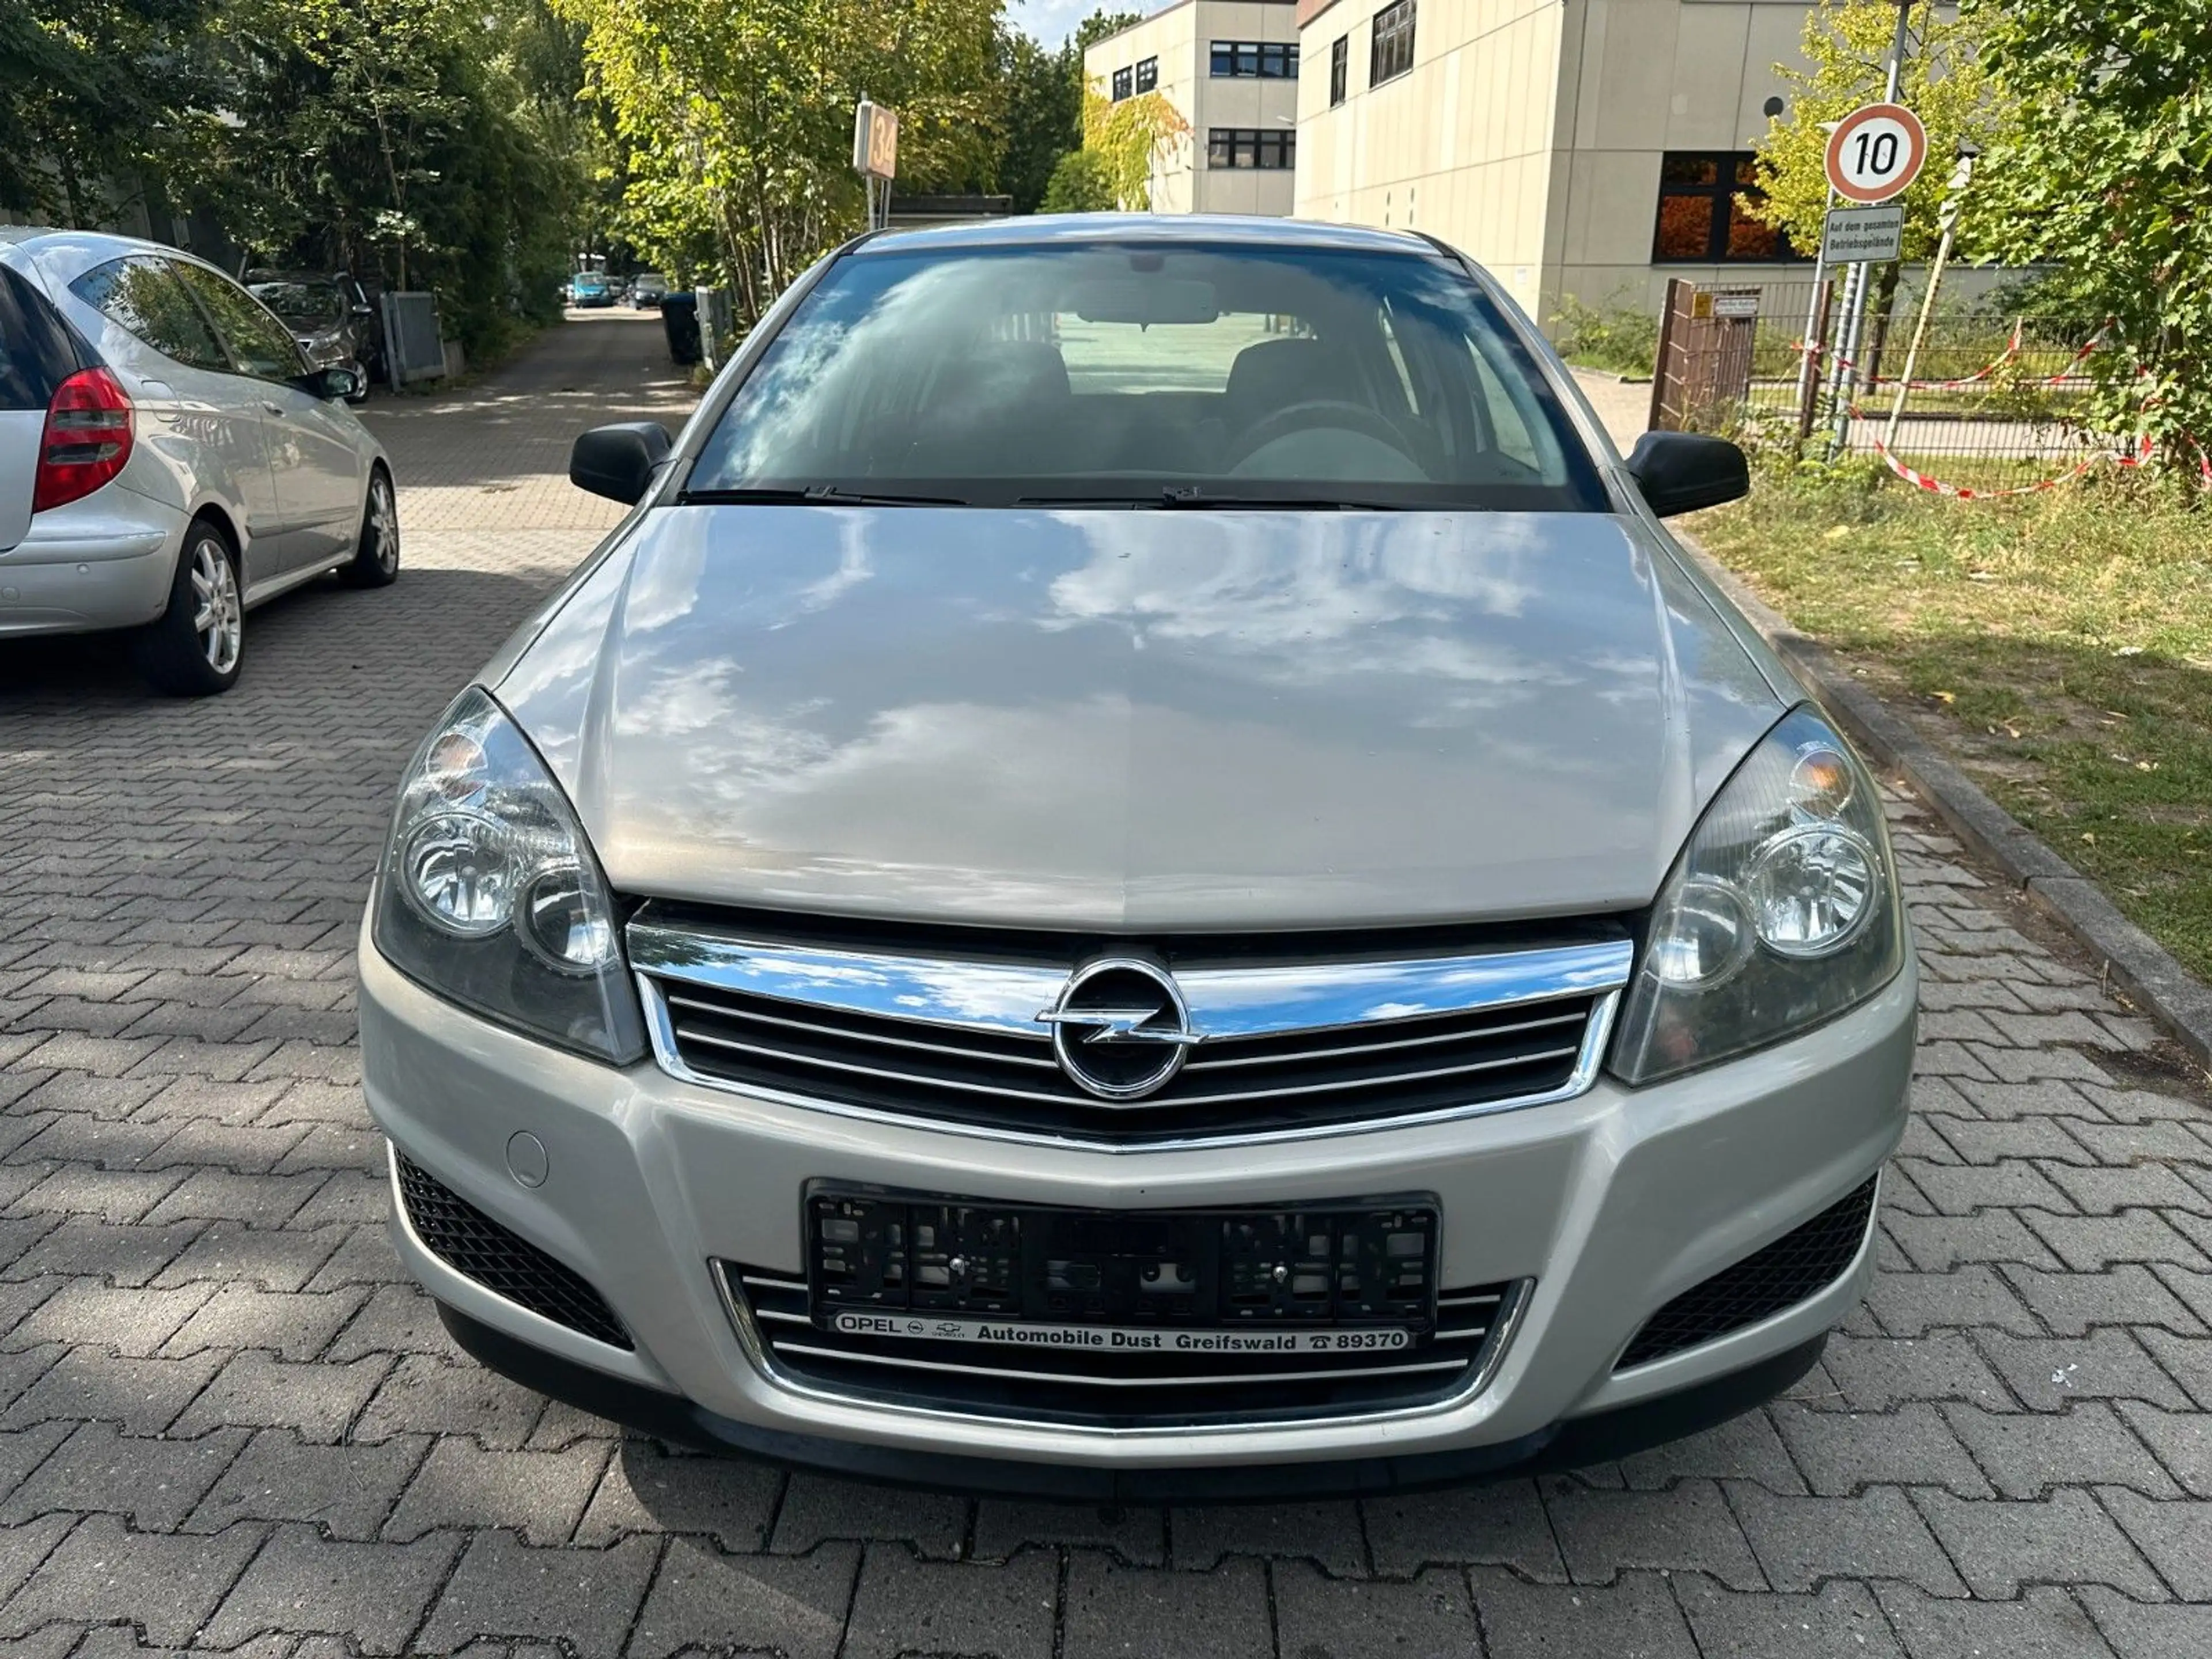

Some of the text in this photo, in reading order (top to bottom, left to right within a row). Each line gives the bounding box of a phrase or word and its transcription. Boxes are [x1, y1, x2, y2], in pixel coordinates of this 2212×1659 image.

[874, 115, 896, 166] 34
[1855, 132, 1898, 175] 10
[1830, 220, 1899, 232] Auf dem gesamten
[1830, 236, 1894, 250] Betriebsgelände
[841, 1316, 902, 1332] OPEL
[978, 1325, 1104, 1346] Automobile
[1111, 1332, 1162, 1347] Dust
[1175, 1334, 1296, 1350] Greifswald
[1336, 1332, 1404, 1349] 89370
